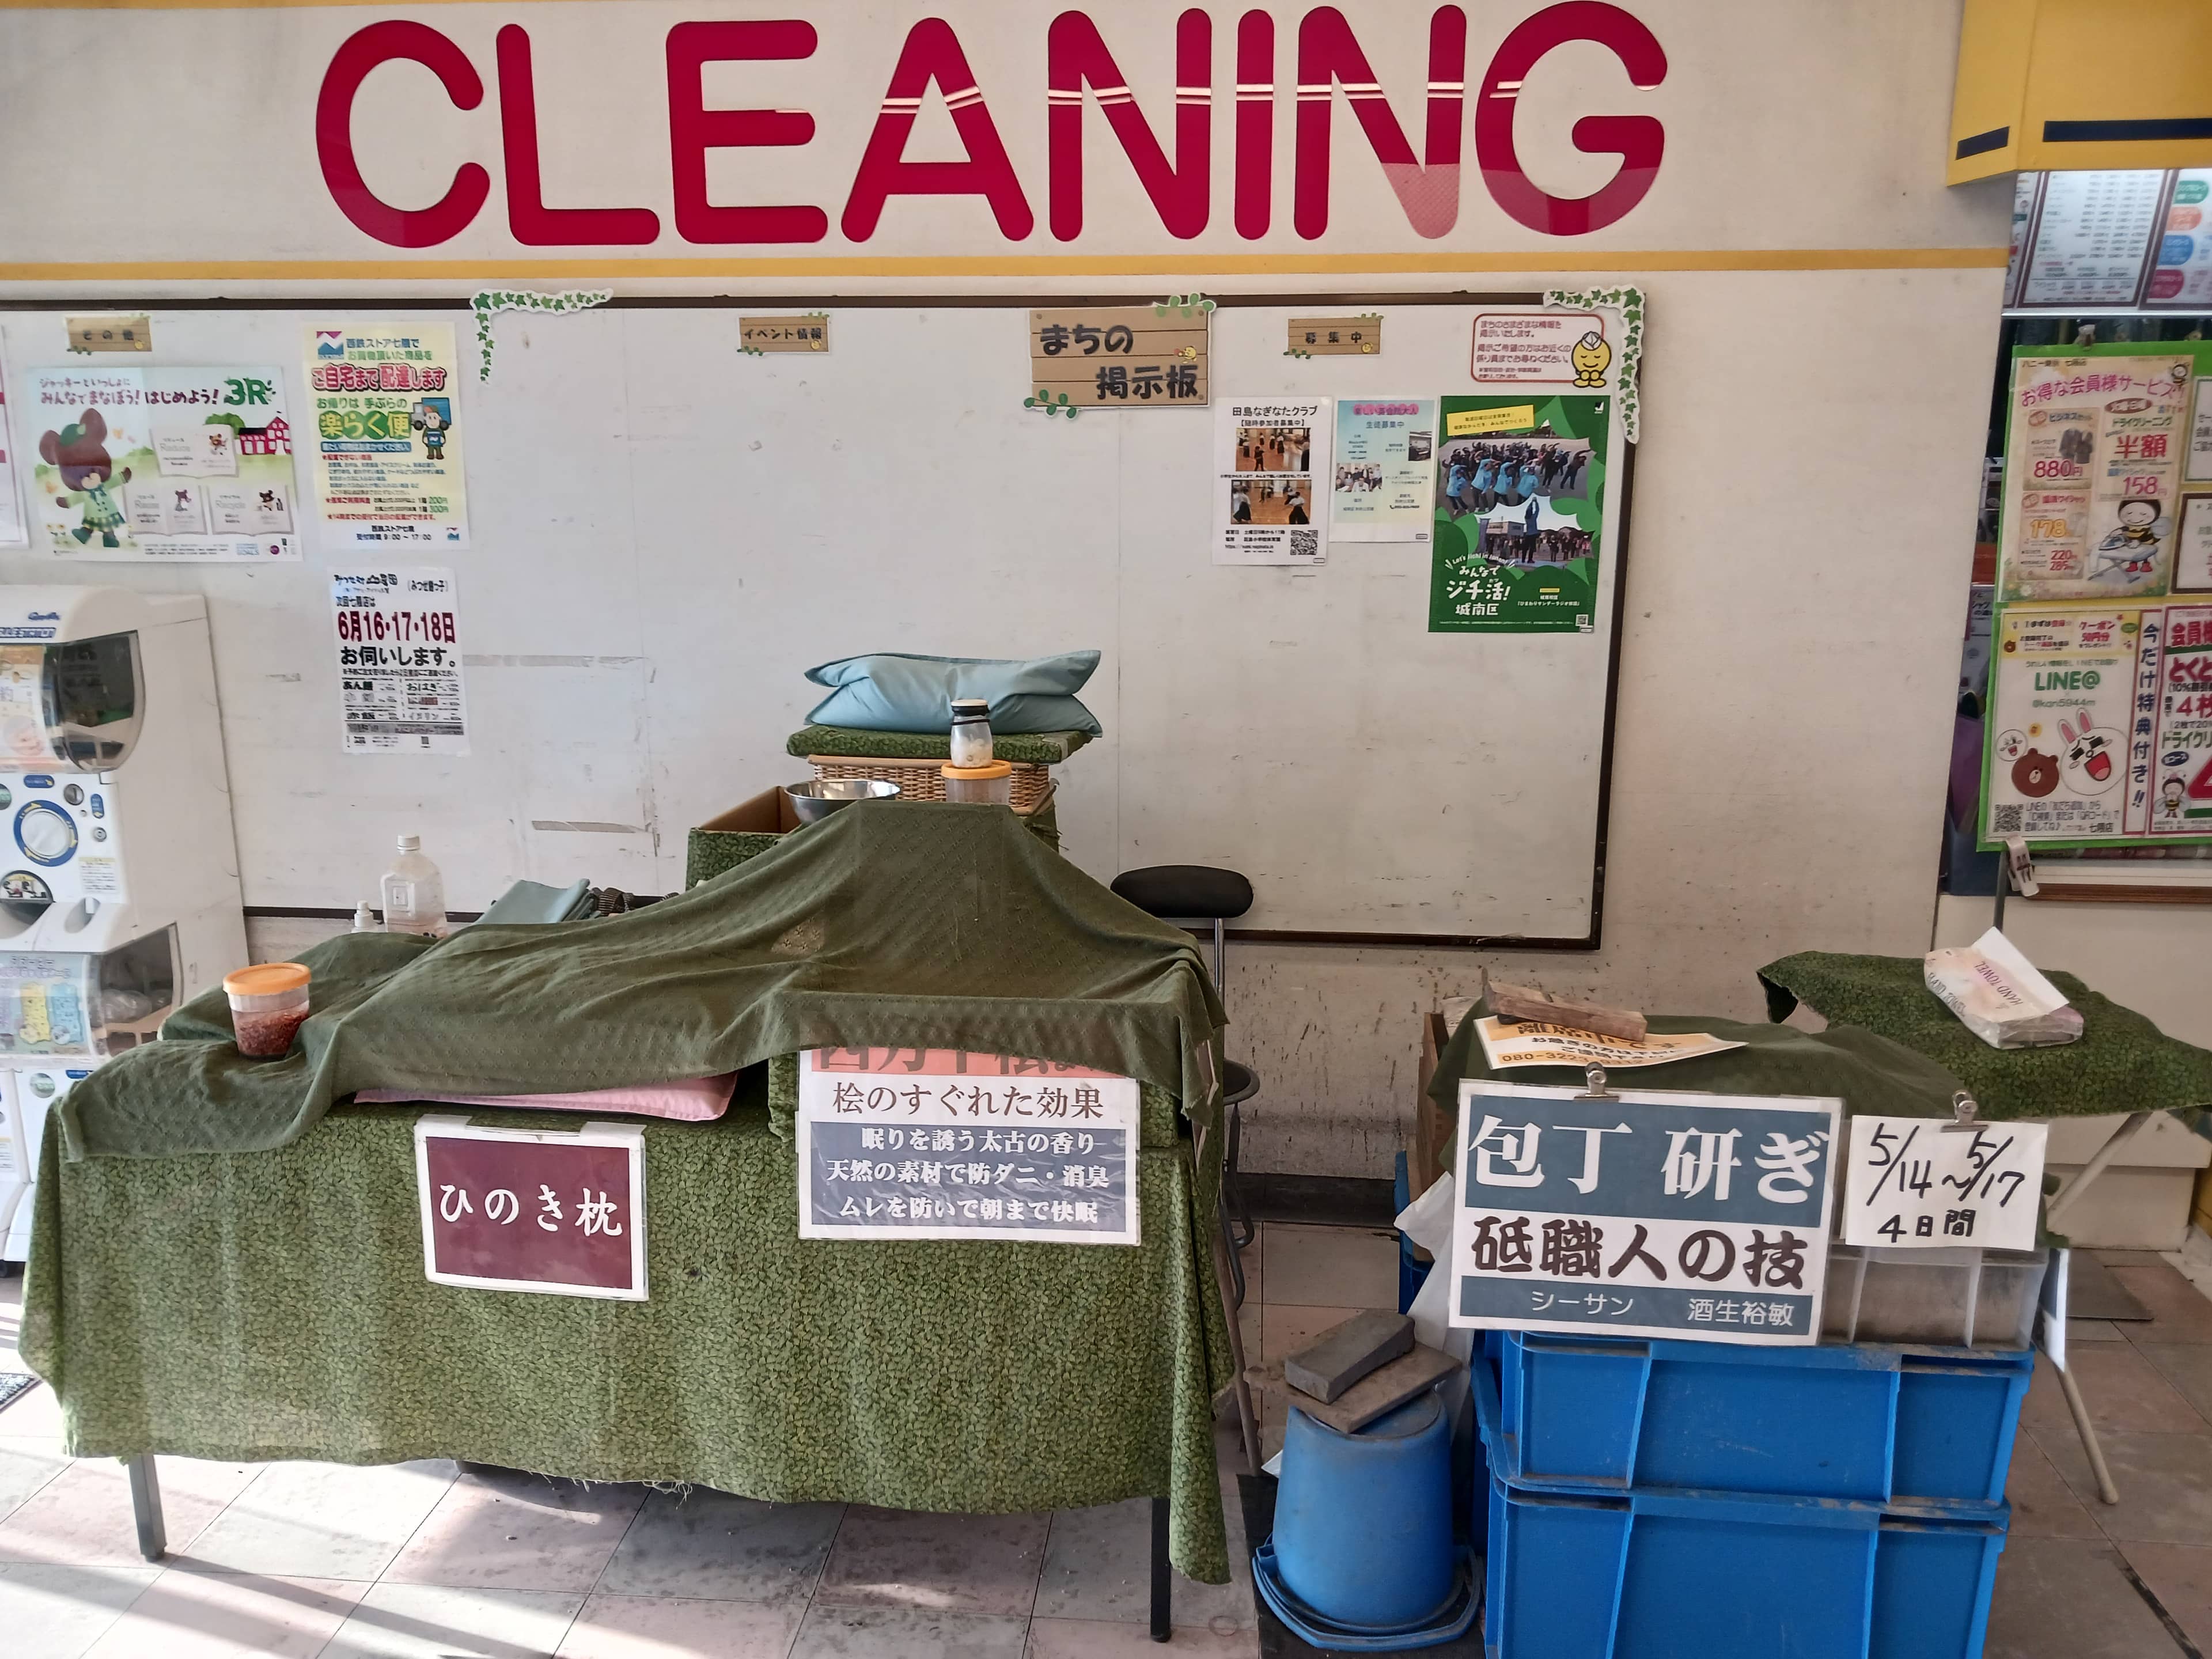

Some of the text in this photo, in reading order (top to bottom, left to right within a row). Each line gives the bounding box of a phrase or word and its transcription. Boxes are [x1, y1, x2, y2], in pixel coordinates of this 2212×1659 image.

[315, 1, 1668, 248] CLEANING
[744, 328, 821, 340] イベント情報
[1040, 324, 1133, 355] まちの
[1305, 331, 1362, 344] 募集中
[224, 377, 269, 406] 3R
[312, 363, 448, 392] ご自宅まで配達します
[1096, 364, 1198, 400] 掲示板
[1233, 406, 1318, 416] 田島なぎなたクラブ
[2113, 434, 2169, 459] 半額
[2034, 460, 2084, 478] 880円
[1459, 566, 1501, 577] みんなで
[1446, 579, 1511, 601] ジチ活!
[1455, 603, 1499, 616] 城南区
[338, 611, 456, 643] 6月16・17・18日
[340, 646, 456, 667] お伺いします。
[2034, 670, 2101, 691] LINE@
[1997, 986, 2024, 1005] HAND
[832, 1081, 1104, 1119] 桧のすぐれた効果
[861, 1127, 1095, 1155] 眠りを誘う太古の香り
[826, 1158, 1110, 1189] 天然の素材で防ダニ・消臭
[1468, 1115, 1830, 1204] 包丁 研ぎ
[440, 1184, 623, 1237] ひのき枕
[838, 1195, 1099, 1224] ムレを防いで朝まで快眠
[1877, 1209, 1976, 1243] 4日間
[1471, 1215, 1809, 1290] 砥職人の技
[1531, 1290, 1793, 1327] シーサン 酒生裕敏
